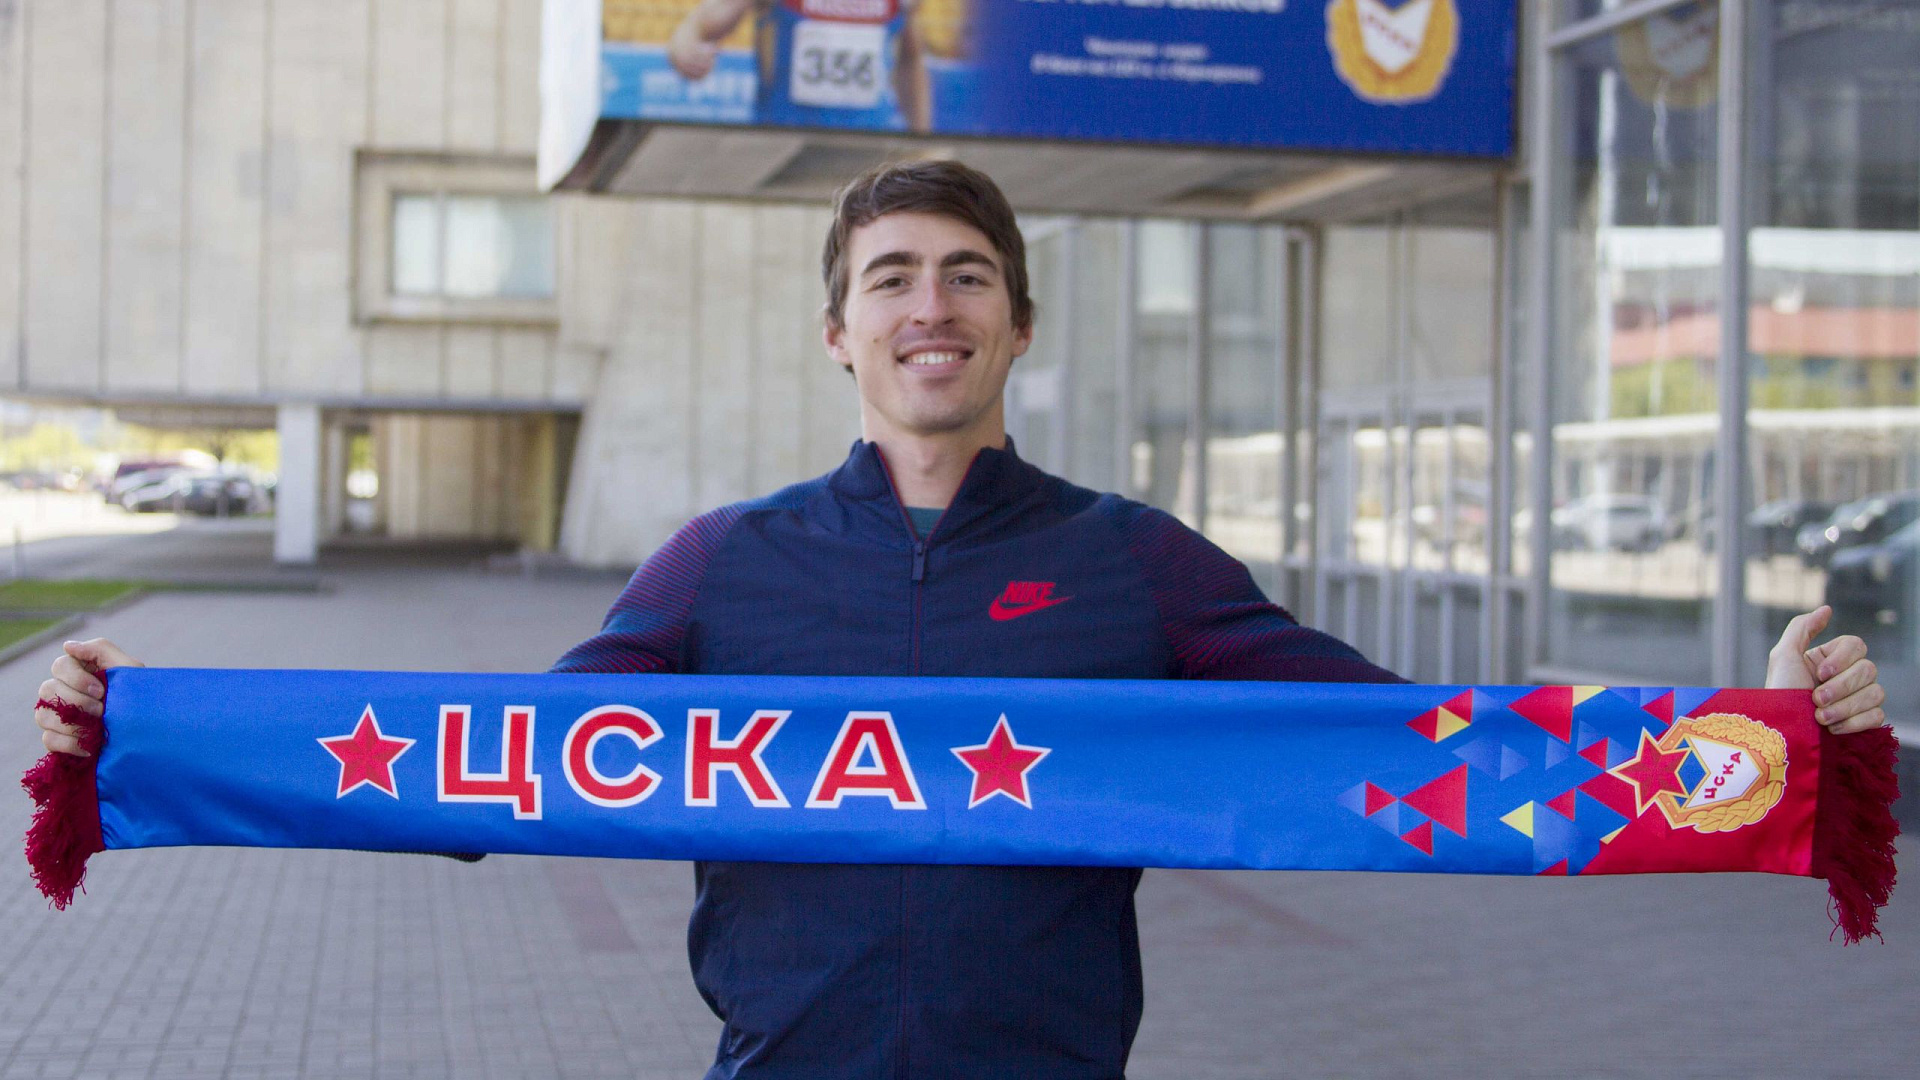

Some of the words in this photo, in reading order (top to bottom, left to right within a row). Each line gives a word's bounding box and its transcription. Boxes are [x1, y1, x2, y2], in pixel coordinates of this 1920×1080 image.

[1002, 581, 1056, 604] NIKE
[437, 704, 927, 820] ЦСКА
[1704, 751, 1742, 799] ЦСКА
